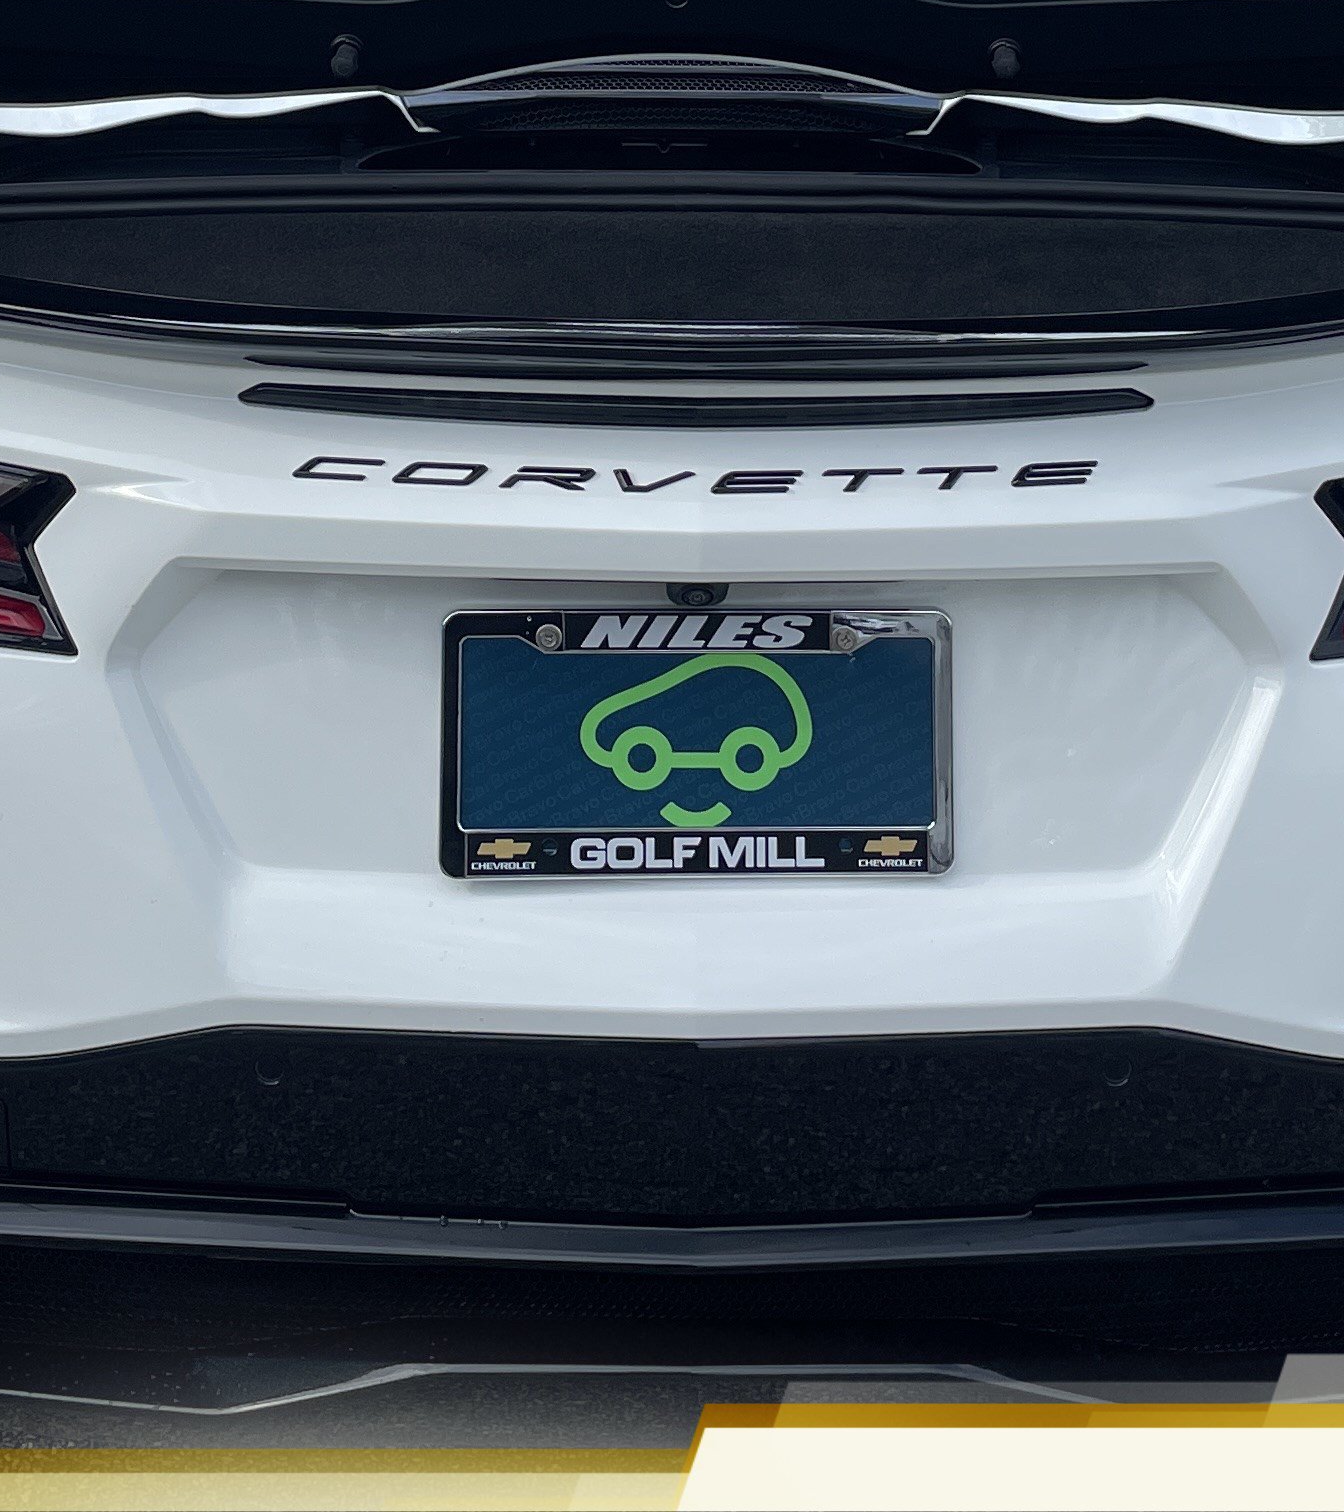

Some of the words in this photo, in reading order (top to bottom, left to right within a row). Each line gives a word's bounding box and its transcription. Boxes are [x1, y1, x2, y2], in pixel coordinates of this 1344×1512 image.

[291, 456, 1100, 496] CORVETTE
[580, 615, 813, 649] NILES
[470, 861, 537, 871] CHEVROLET
[570, 836, 702, 869] GOLF
[708, 836, 826, 868] MILL
[858, 858, 924, 868] CHEVROLET
